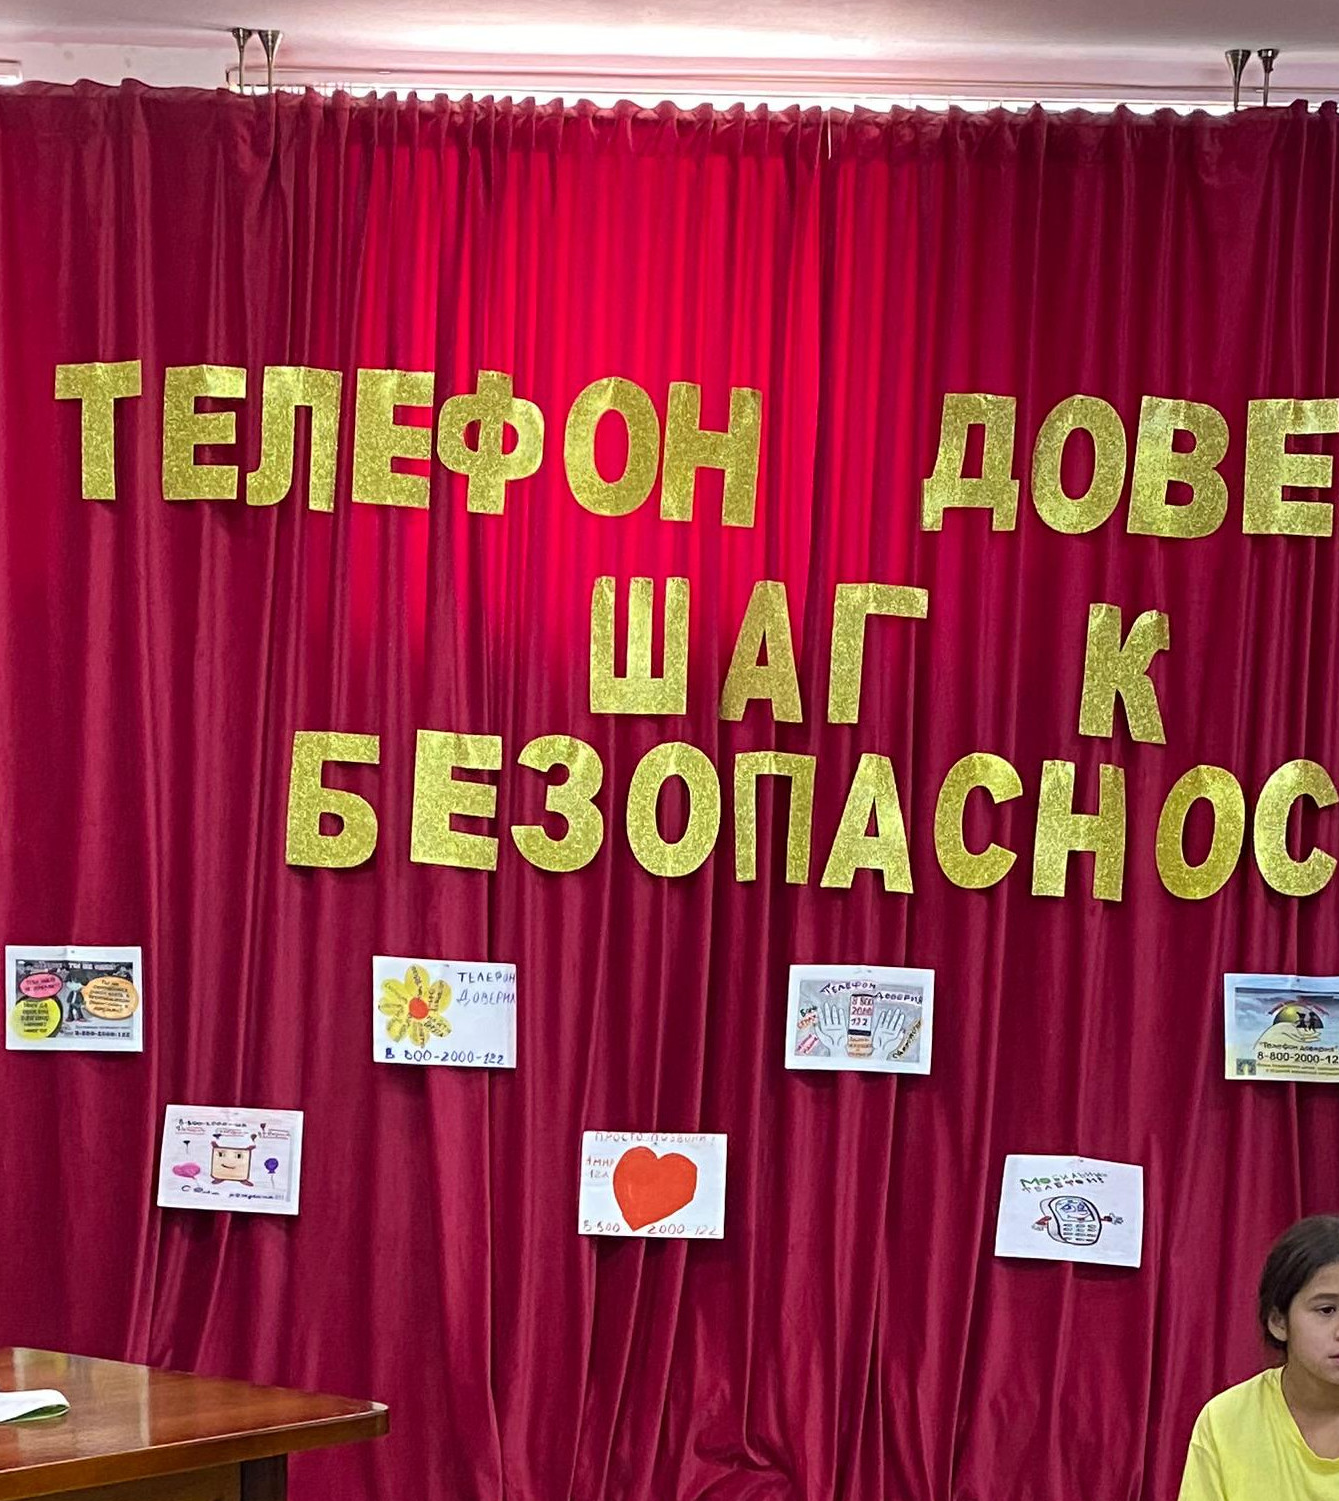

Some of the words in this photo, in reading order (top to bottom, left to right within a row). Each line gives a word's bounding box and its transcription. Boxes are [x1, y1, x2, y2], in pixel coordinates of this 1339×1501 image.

[54, 359, 763, 528] ТЕЛЕФОН
[589, 575, 928, 725] ШАГ
[1077, 602, 1170, 746] К
